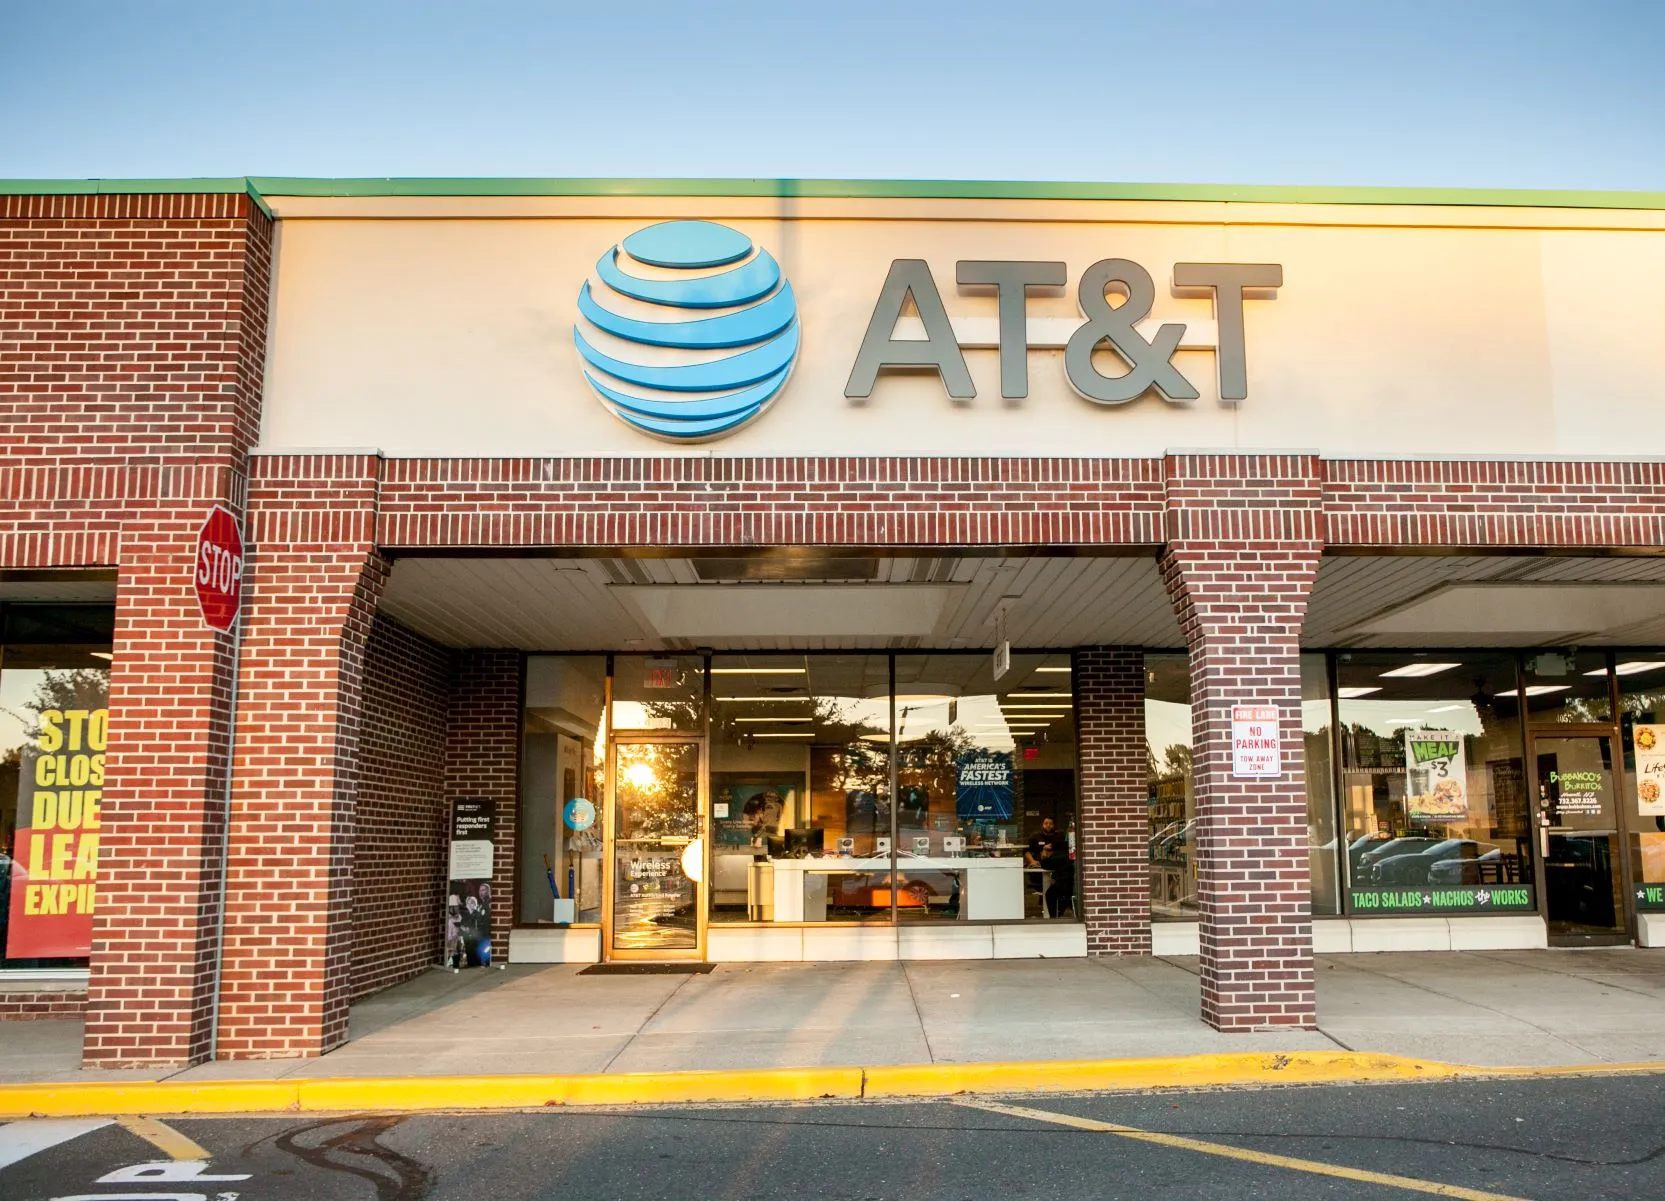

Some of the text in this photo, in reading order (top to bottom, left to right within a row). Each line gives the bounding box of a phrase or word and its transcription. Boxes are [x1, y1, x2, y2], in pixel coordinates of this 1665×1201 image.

[843, 257, 1284, 405] AT&T
[199, 540, 241, 596] STOP
[1235, 709, 1277, 719] FIRE LANE
[1249, 726, 1262, 737] NO
[1236, 738, 1277, 749] PARKING
[1412, 741, 1457, 761] MEAL
[1249, 763, 1264, 771] ZONE
[1431, 760, 1449, 778] $3
[960, 770, 1010, 781] FASTEST
[32, 790, 102, 830] DUE
[456, 816, 477, 824] Putting
[630, 860, 671, 870] Wireless
[630, 870, 667, 879] Experience
[1352, 889, 1529, 908] TACO SALADS NACHOS the WORKS
[1646, 887, 1664, 902] WE
